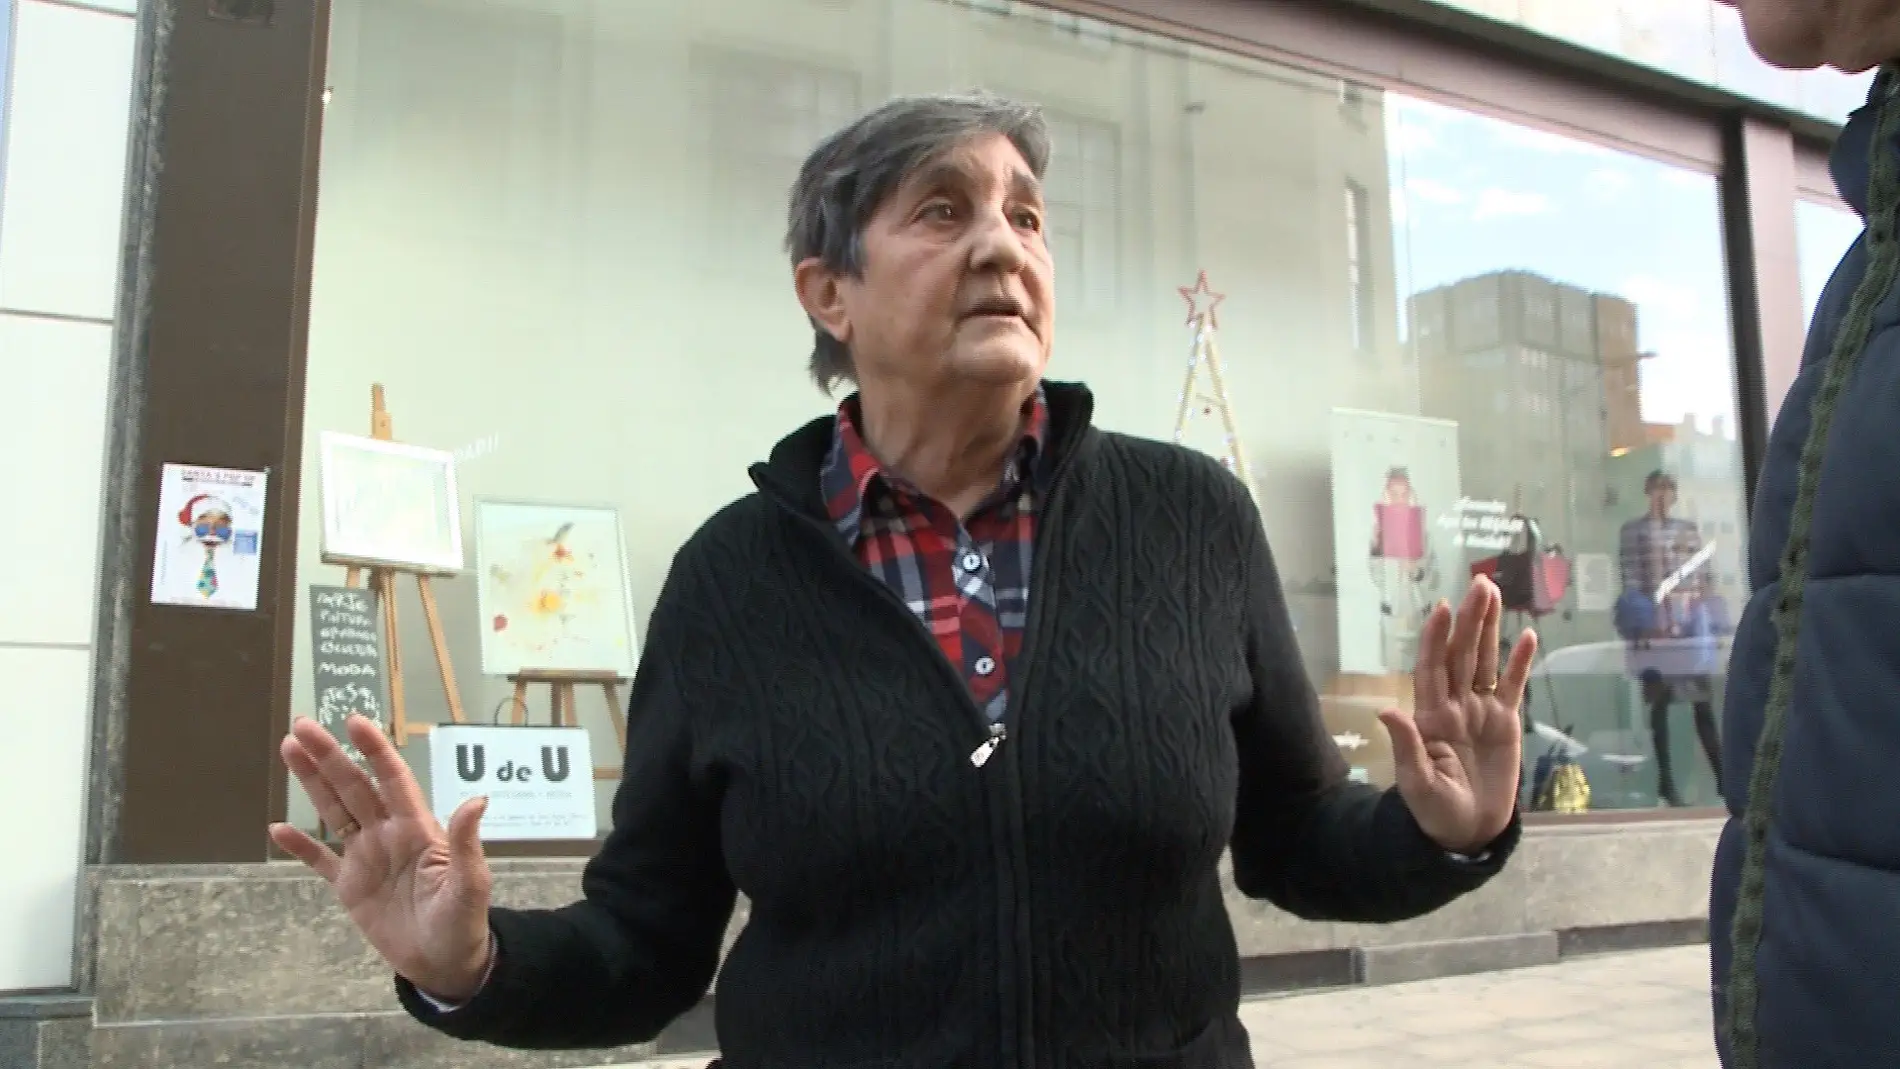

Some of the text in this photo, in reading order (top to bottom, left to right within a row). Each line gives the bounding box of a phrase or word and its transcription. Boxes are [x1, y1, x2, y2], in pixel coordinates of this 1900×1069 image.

[318, 661, 377, 677] MODA
[456, 744, 570, 782] U de U
